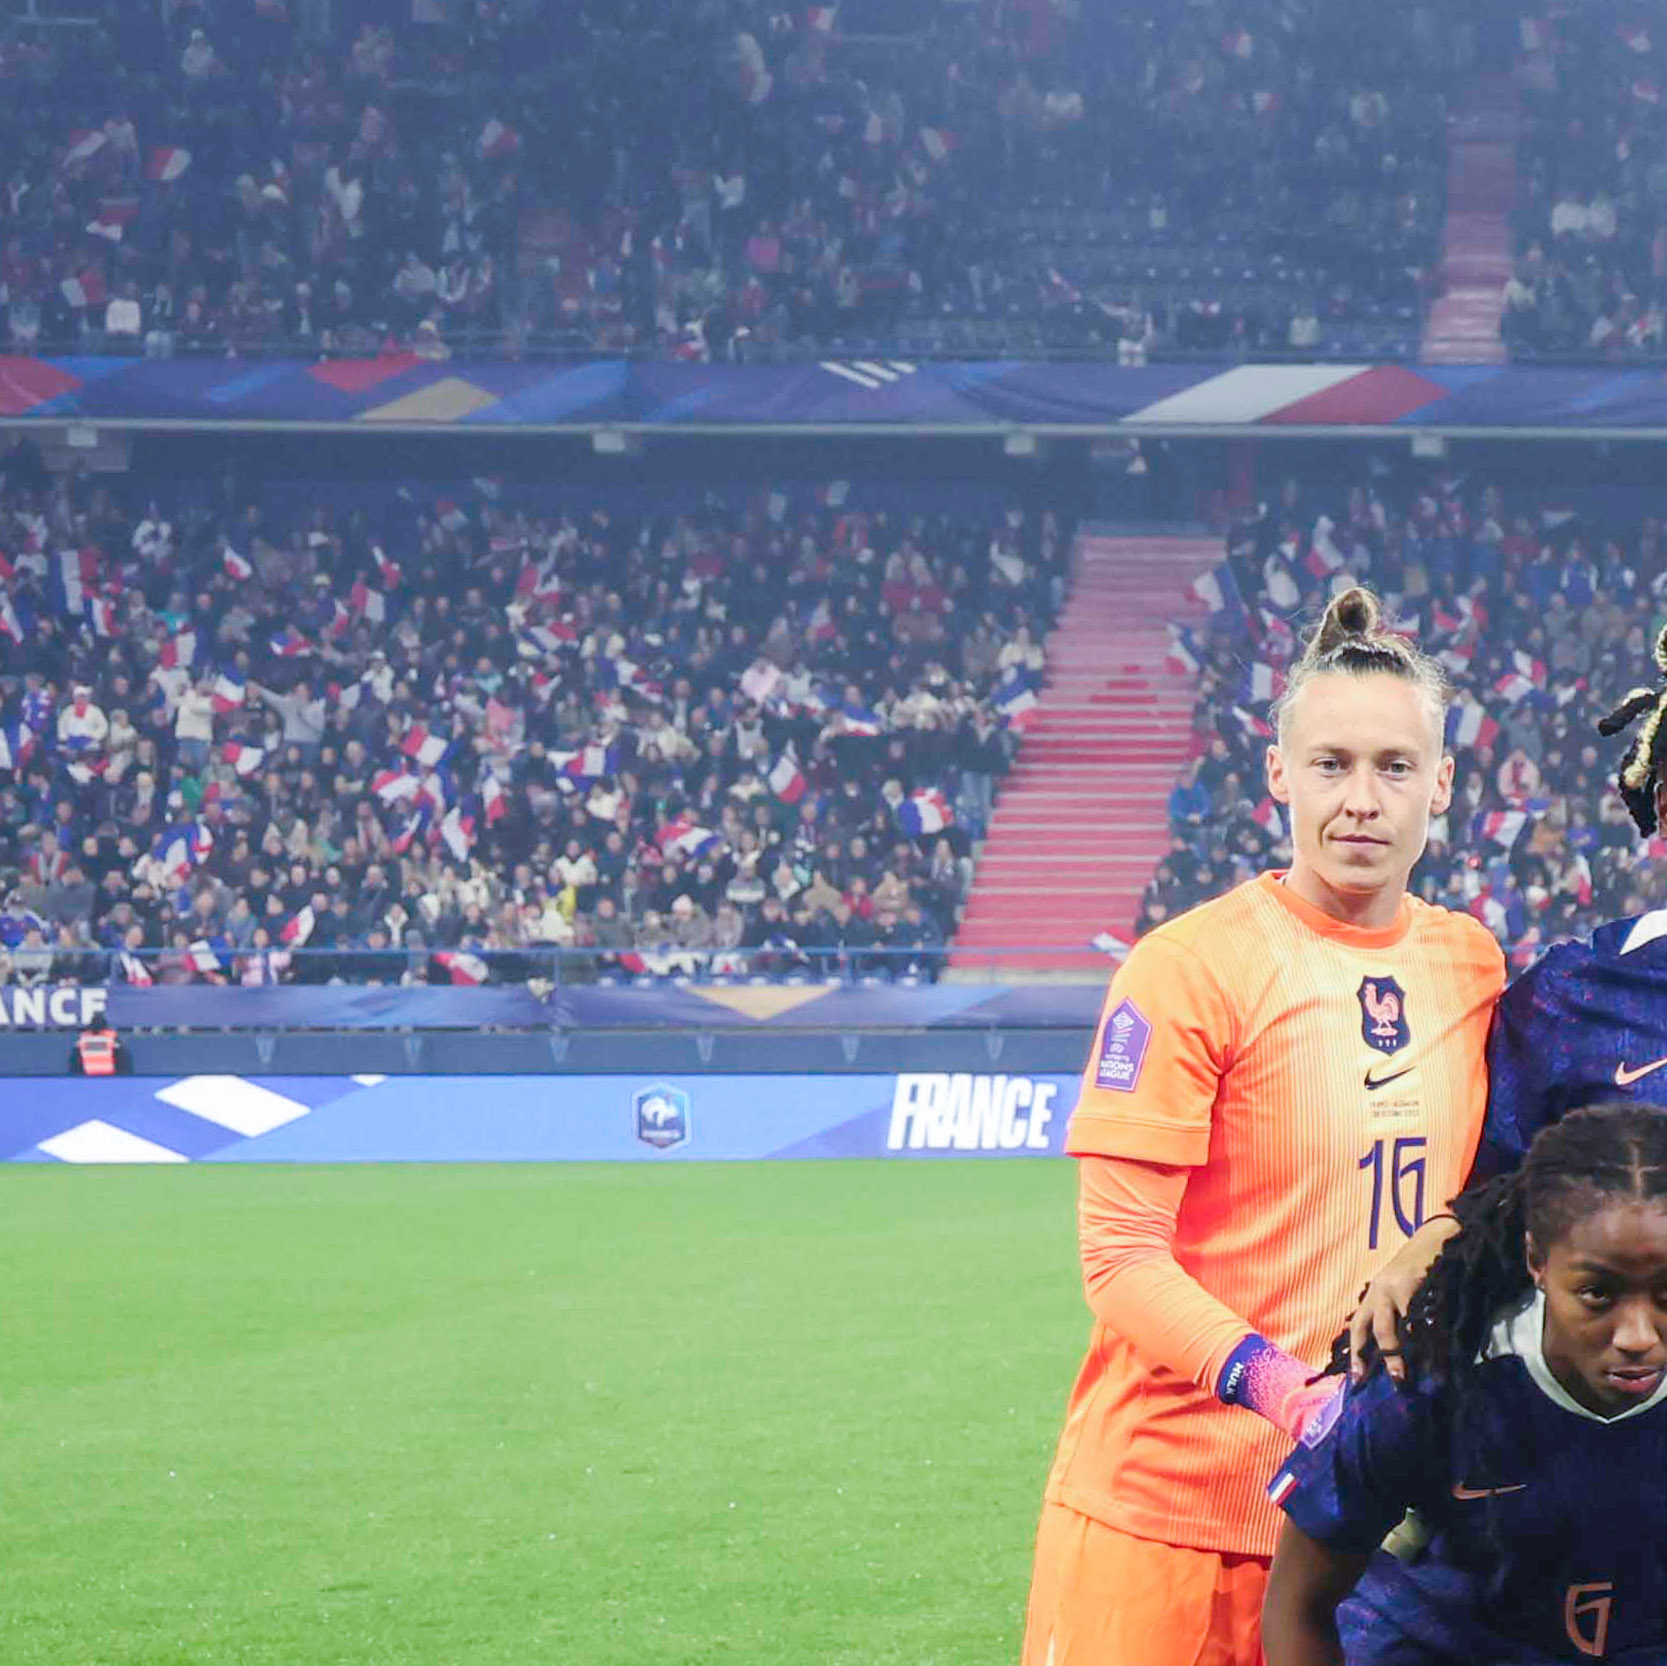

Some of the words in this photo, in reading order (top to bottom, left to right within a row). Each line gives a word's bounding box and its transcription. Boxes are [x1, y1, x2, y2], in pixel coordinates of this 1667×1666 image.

[887, 1073, 1057, 1149] FRANCE
[1358, 1136, 1427, 1250] 16
[1565, 1582, 1613, 1656] 6
